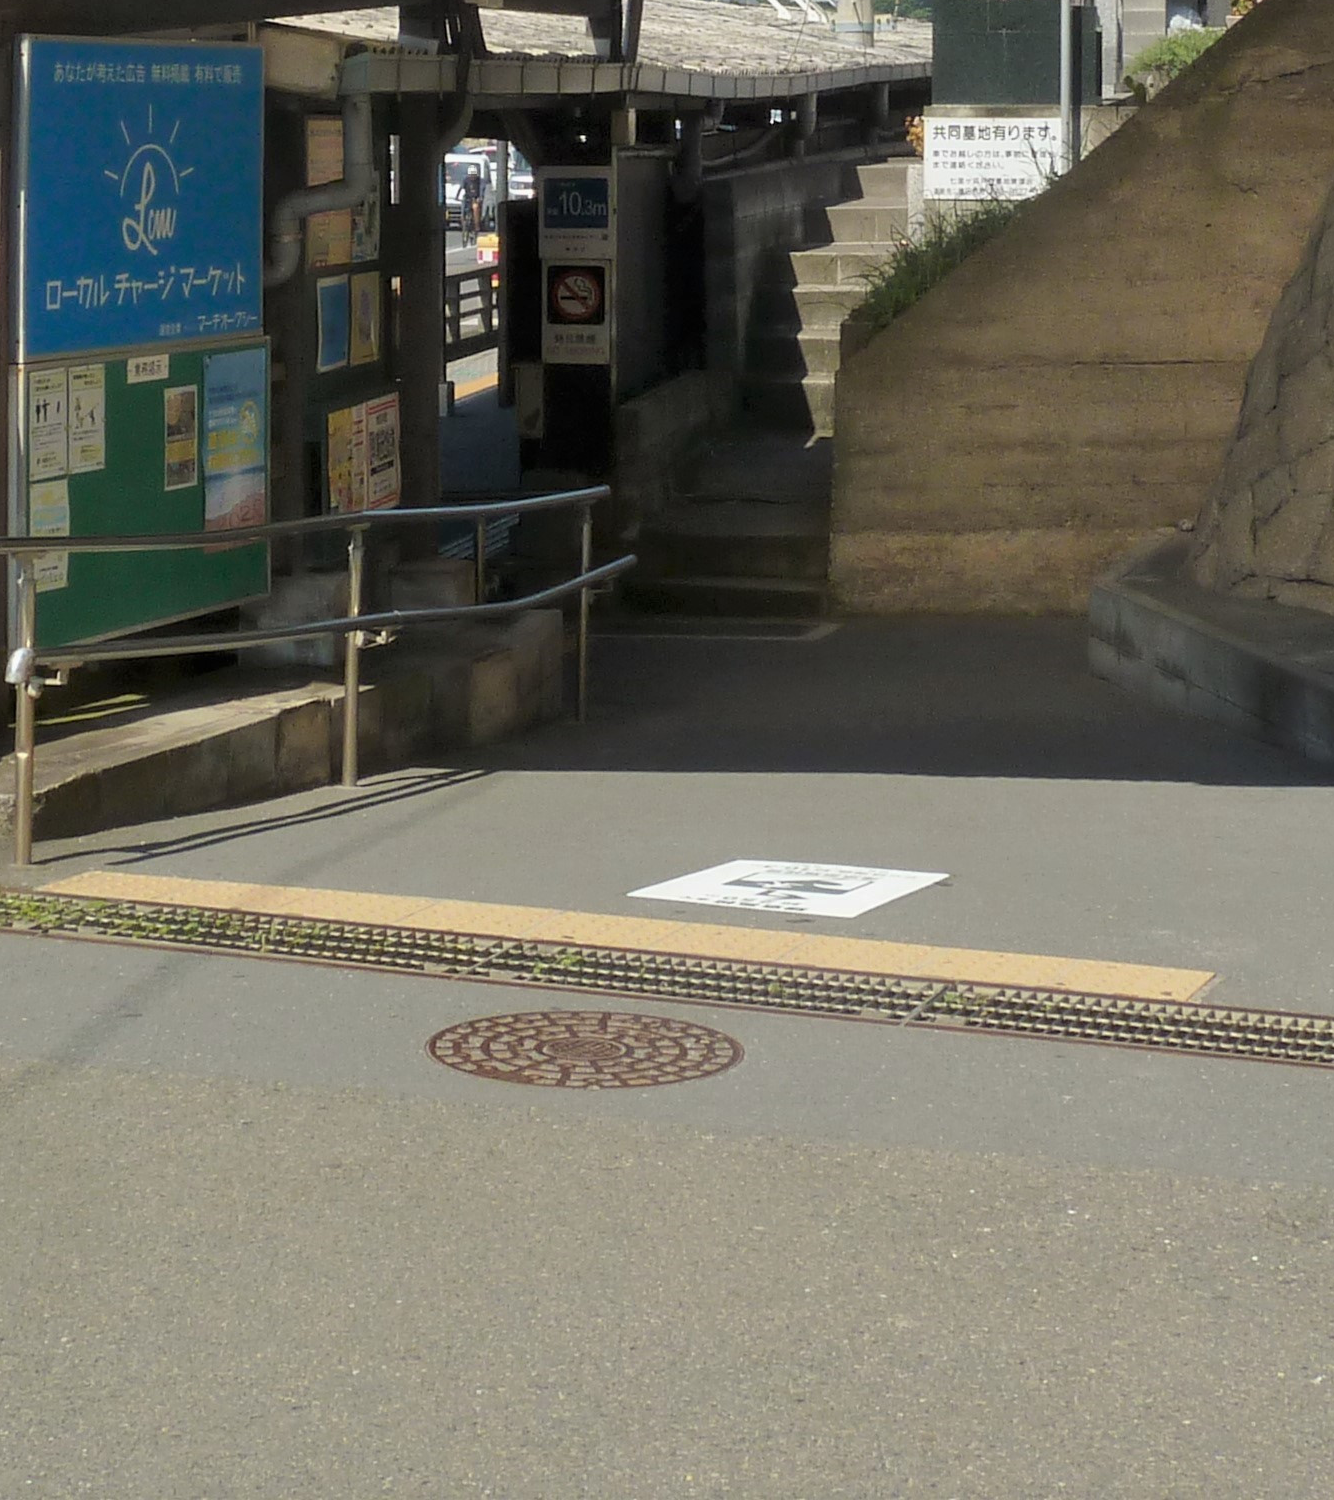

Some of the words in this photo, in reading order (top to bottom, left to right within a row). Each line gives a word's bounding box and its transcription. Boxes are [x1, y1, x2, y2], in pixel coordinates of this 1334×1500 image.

[932, 125, 1058, 141] 共同墓地有ります。
[558, 191, 607, 216] 10.3m
[46, 274, 111, 311] ローカル
[114, 265, 177, 305] チャージ
[179, 262, 246, 299] マーケット
